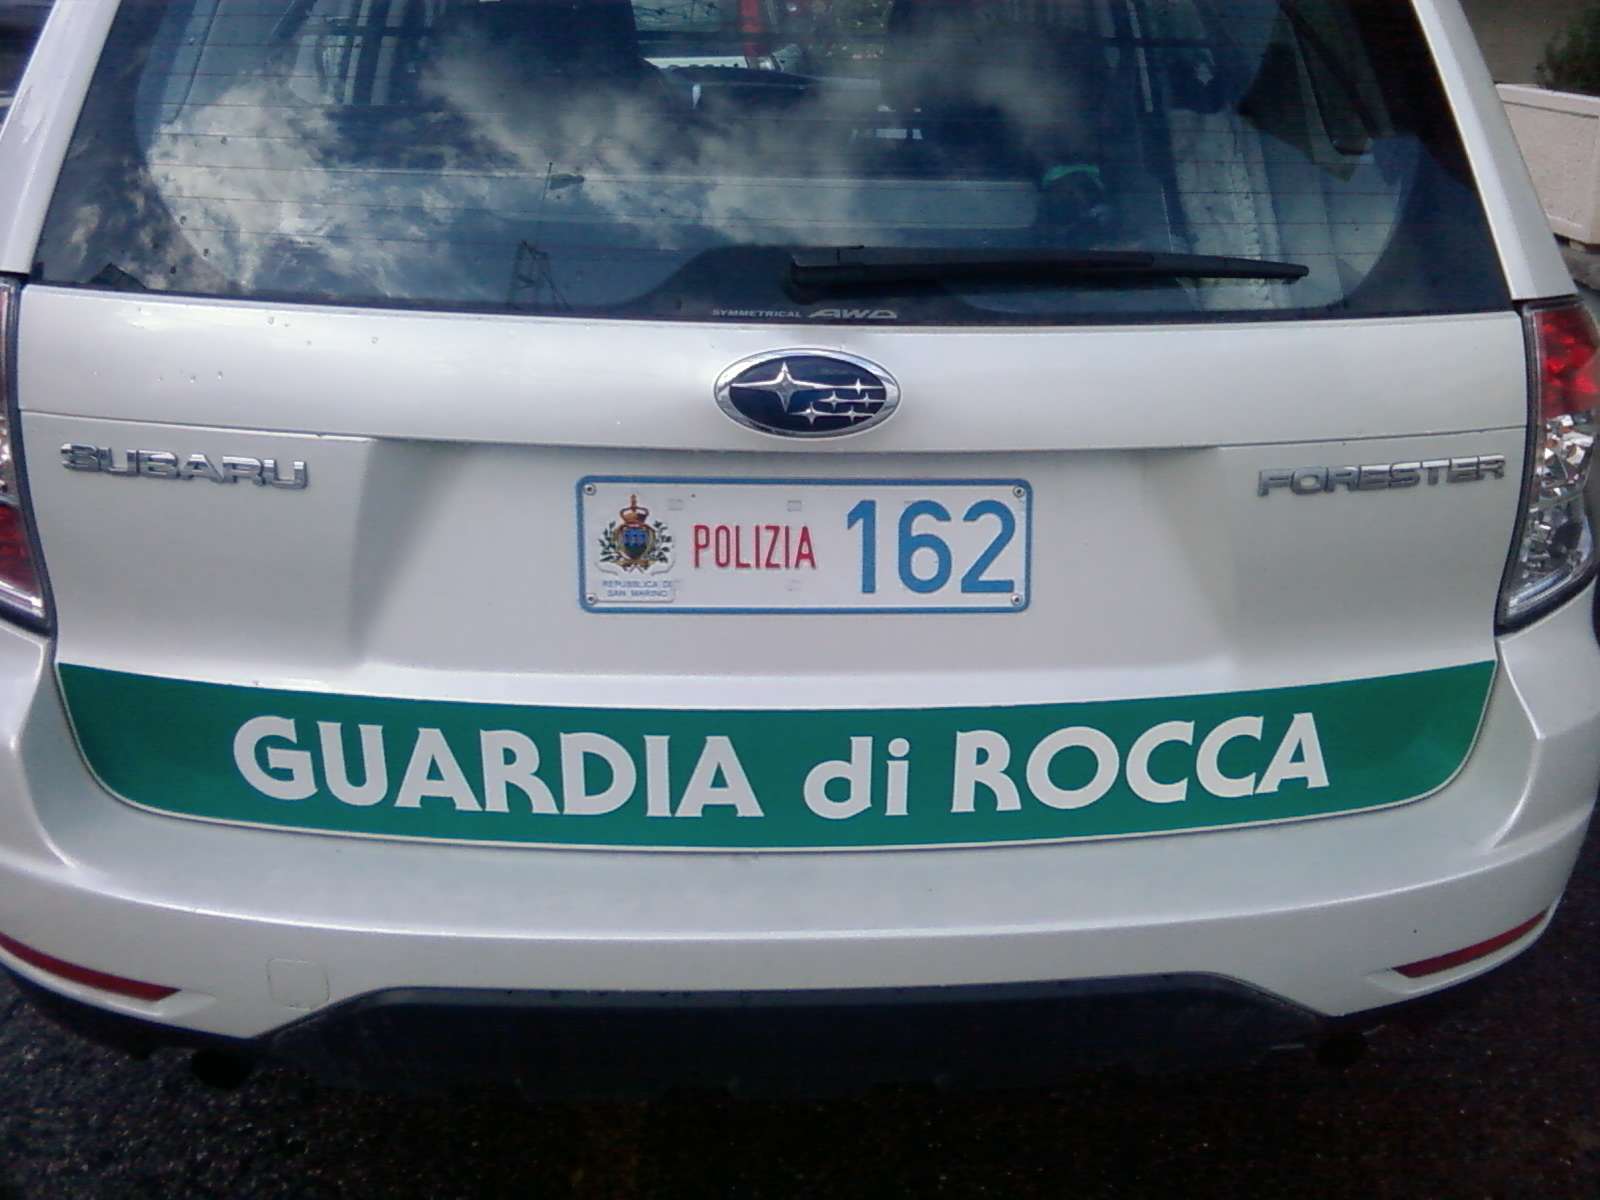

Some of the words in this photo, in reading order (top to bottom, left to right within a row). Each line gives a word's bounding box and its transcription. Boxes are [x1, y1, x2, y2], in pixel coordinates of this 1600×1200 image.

[712, 308, 803, 318] SYMMETRICAL
[808, 308, 898, 319] AWD
[60, 443, 308, 489] SUBARU
[1258, 453, 1506, 497] FORESTER
[694, 524, 817, 569] POLIZIA
[847, 499, 1016, 594] 162
[233, 715, 765, 818] GUARDIA
[803, 736, 910, 820] di
[950, 712, 1330, 814] ROCCA
